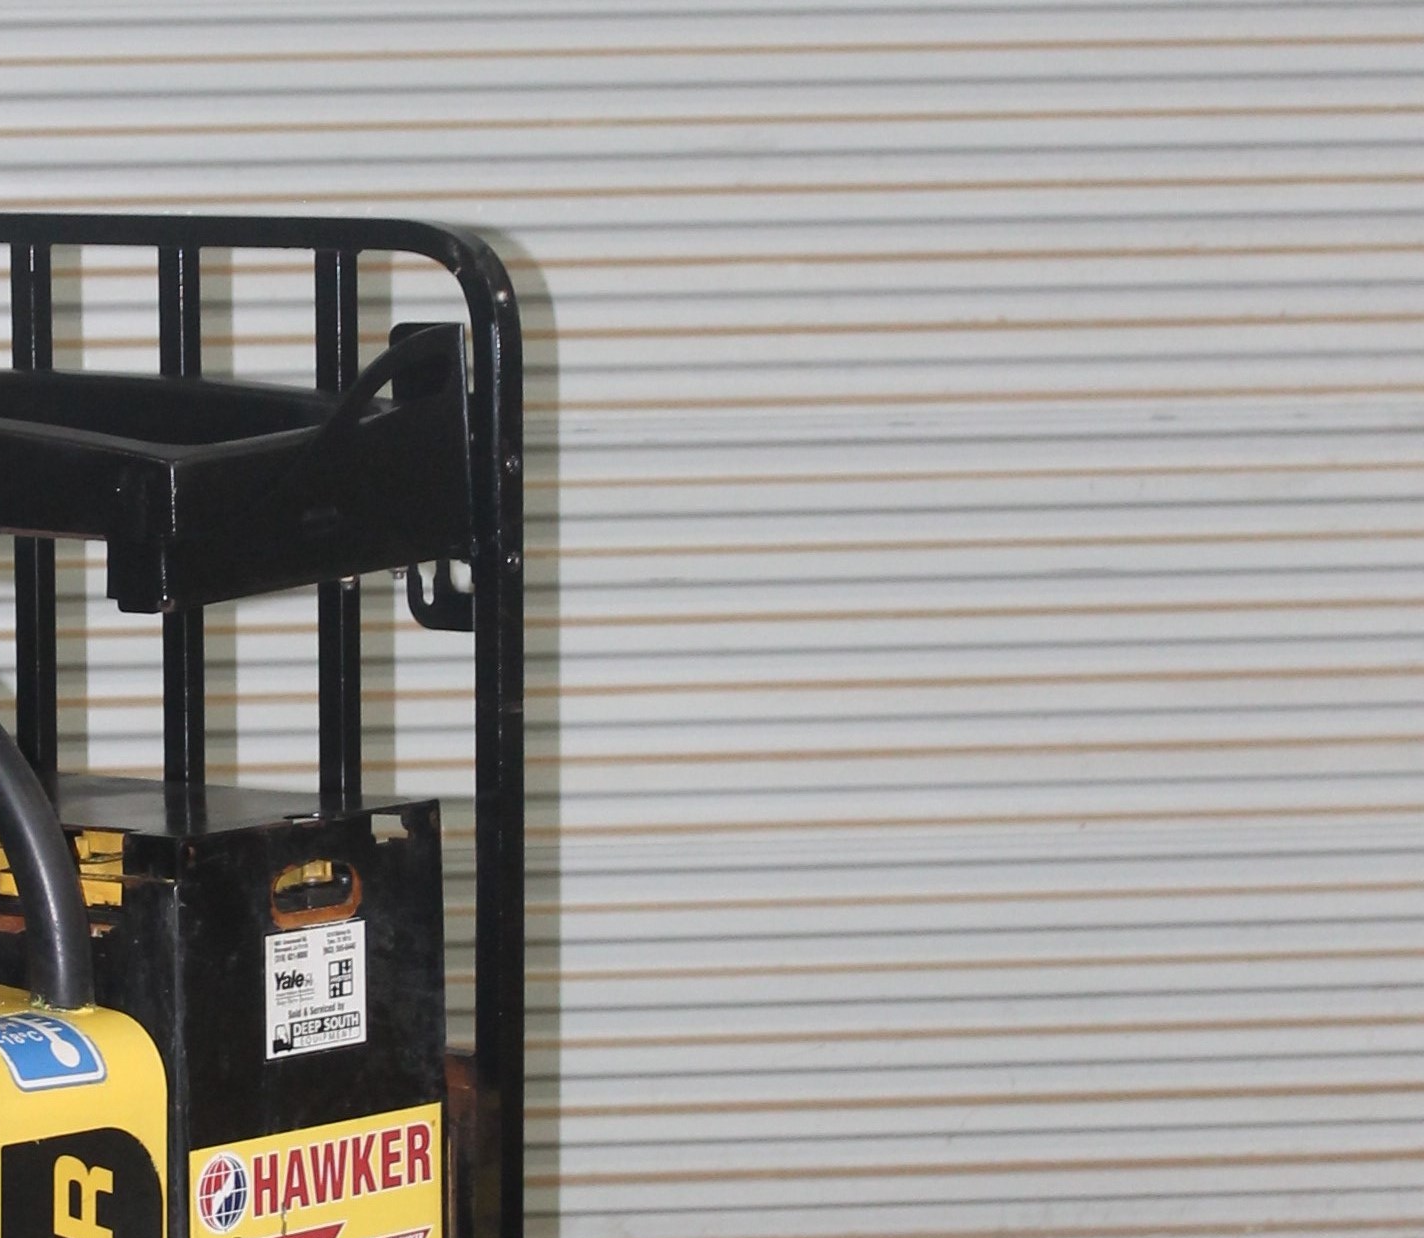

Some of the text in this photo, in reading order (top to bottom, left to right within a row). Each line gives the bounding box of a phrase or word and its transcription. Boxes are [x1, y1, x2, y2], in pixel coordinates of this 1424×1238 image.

[275, 969, 304, 990] Yale
[293, 1014, 359, 1036] DEEP SOUTH
[253, 1123, 431, 1217] HAWKER
